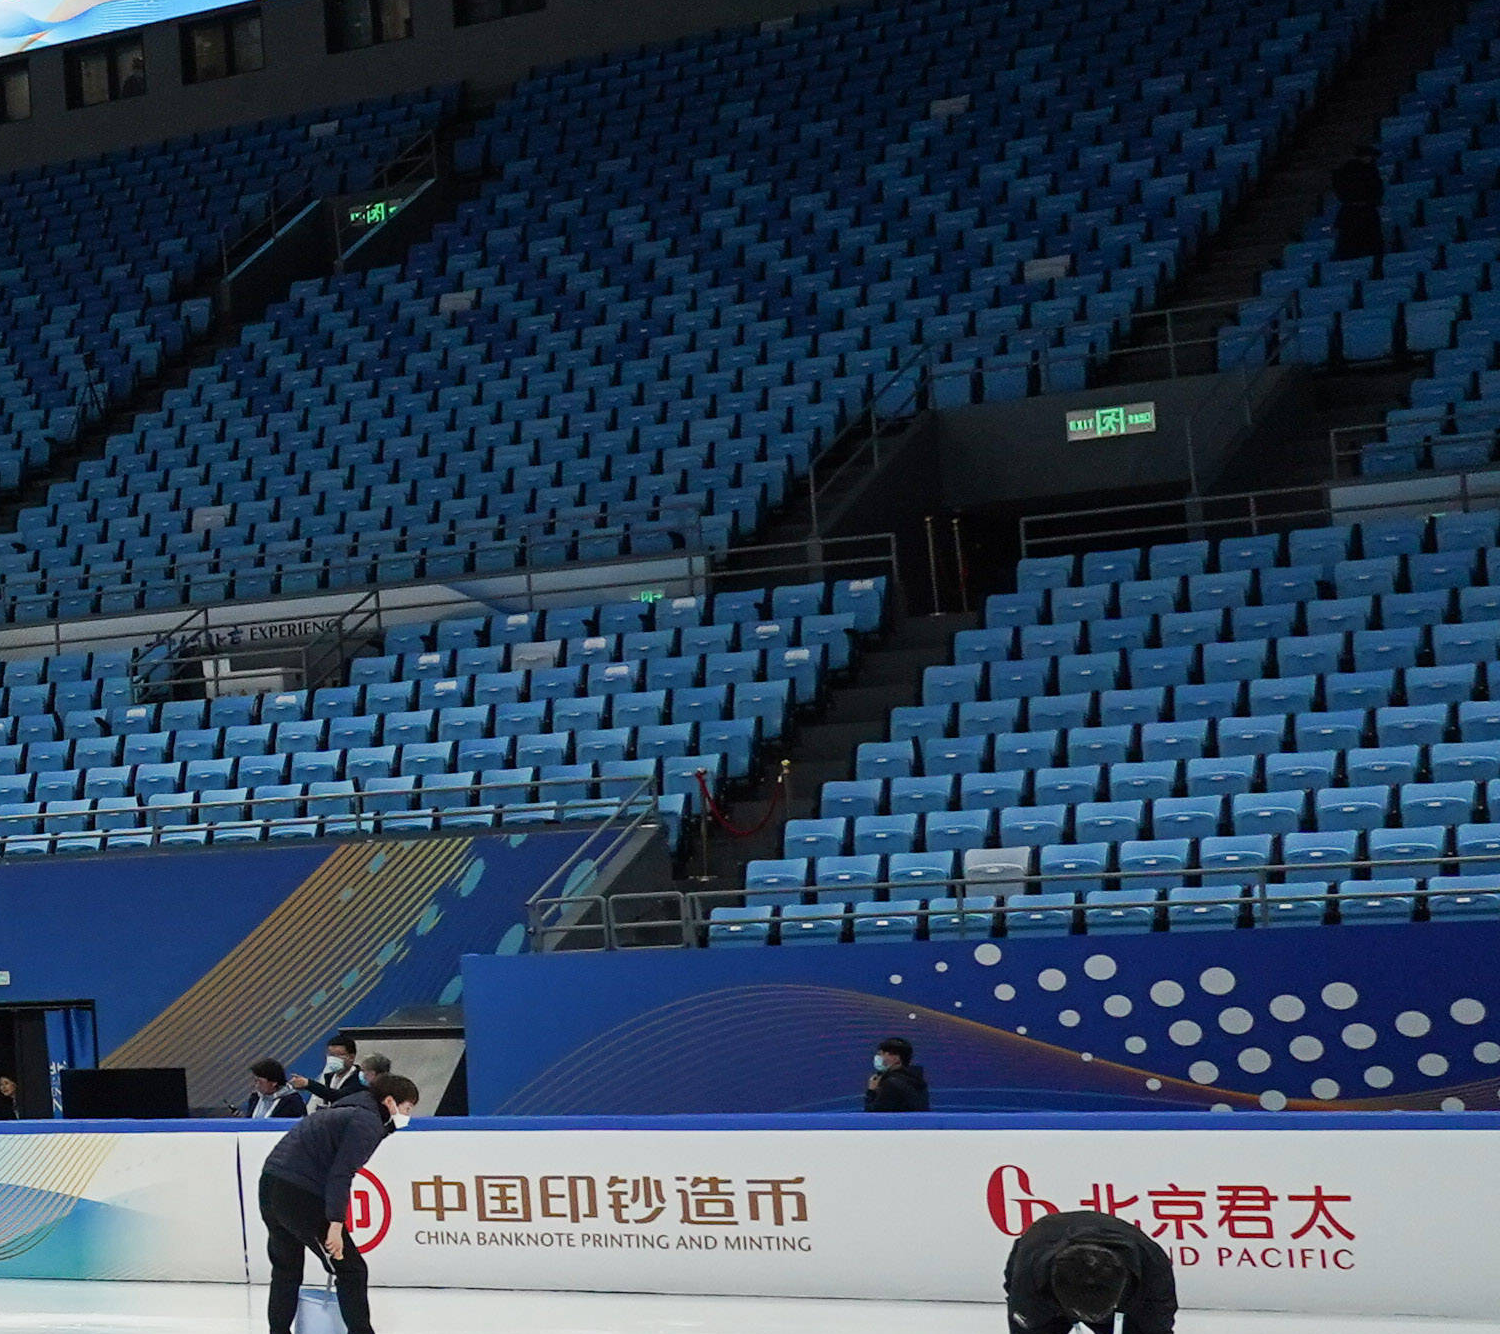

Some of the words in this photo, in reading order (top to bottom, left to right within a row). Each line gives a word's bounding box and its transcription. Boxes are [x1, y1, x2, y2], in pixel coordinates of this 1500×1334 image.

[250, 618, 345, 641] EXPERIENC
[411, 1174, 808, 1227] 中国印钞造币
[1080, 1183, 1356, 1241] 北京君太
[414, 1230, 471, 1247] CHINA
[476, 1231, 577, 1249] BANKNOTE
[581, 1233, 670, 1251] PRINTING
[676, 1235, 718, 1251] AND
[724, 1235, 813, 1252] MINTING
[1217, 1245, 1356, 1270] PACIFIC
